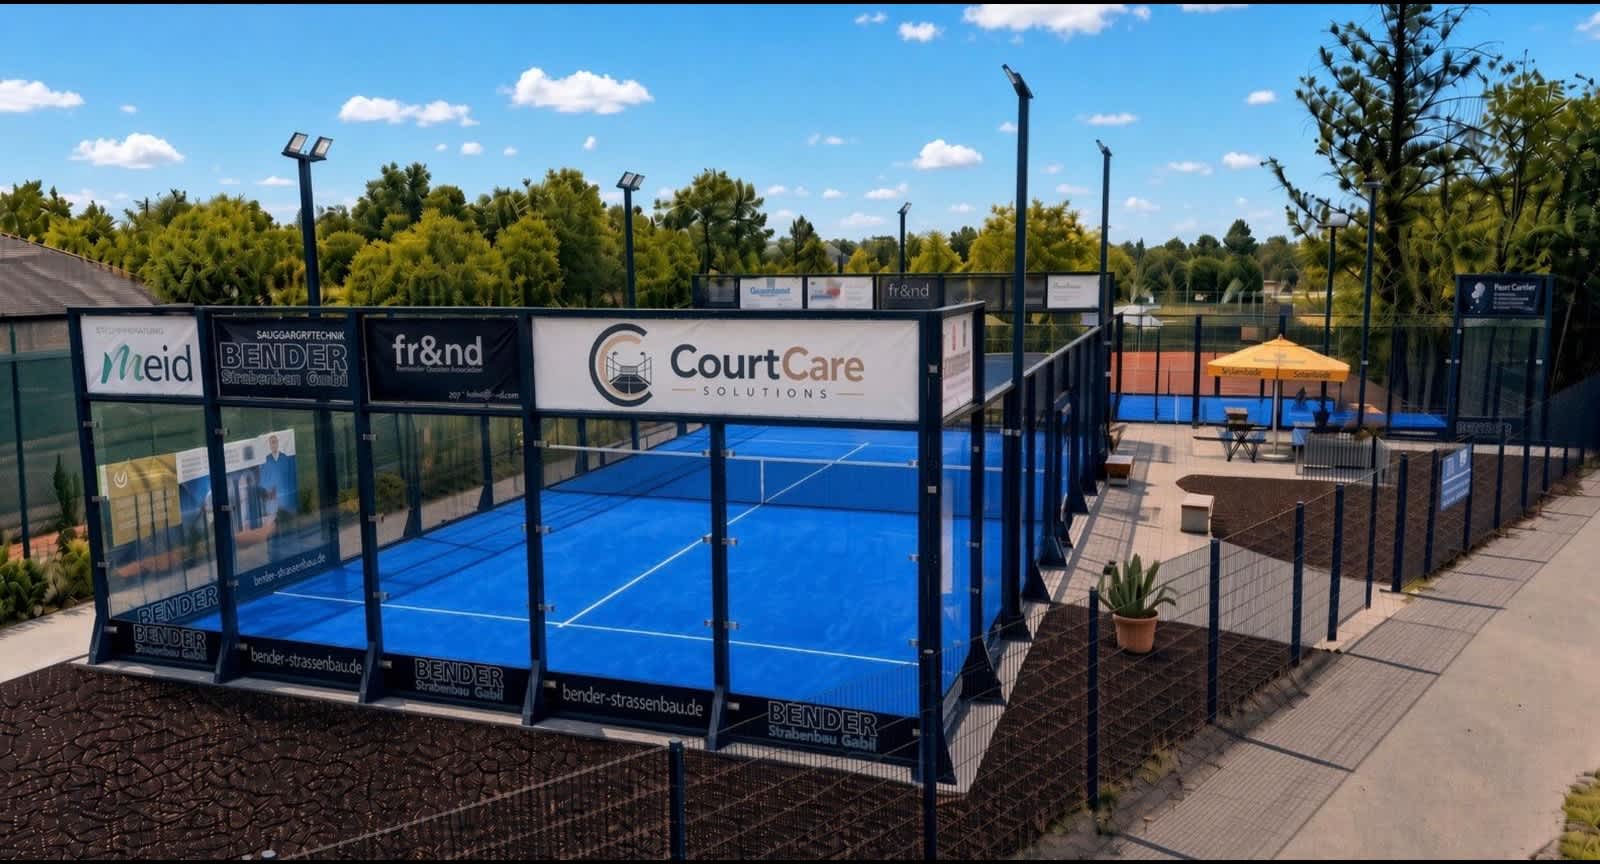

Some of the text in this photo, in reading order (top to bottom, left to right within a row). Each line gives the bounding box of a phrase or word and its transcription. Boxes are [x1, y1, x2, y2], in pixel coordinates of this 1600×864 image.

[888, 283, 929, 297] fr&nd
[219, 342, 348, 371] BENDER
[392, 334, 483, 366] fr&nd
[670, 343, 865, 382] CourtCare
[703, 386, 828, 399] SOLUTIONS
[137, 585, 219, 625] BENDER
[133, 624, 207, 649] BENDER
[251, 650, 362, 675] bender-strassenbau.de
[415, 658, 504, 688] BENDER
[562, 683, 704, 718] bender-strassenbau.de
[768, 701, 878, 737] BENDER
